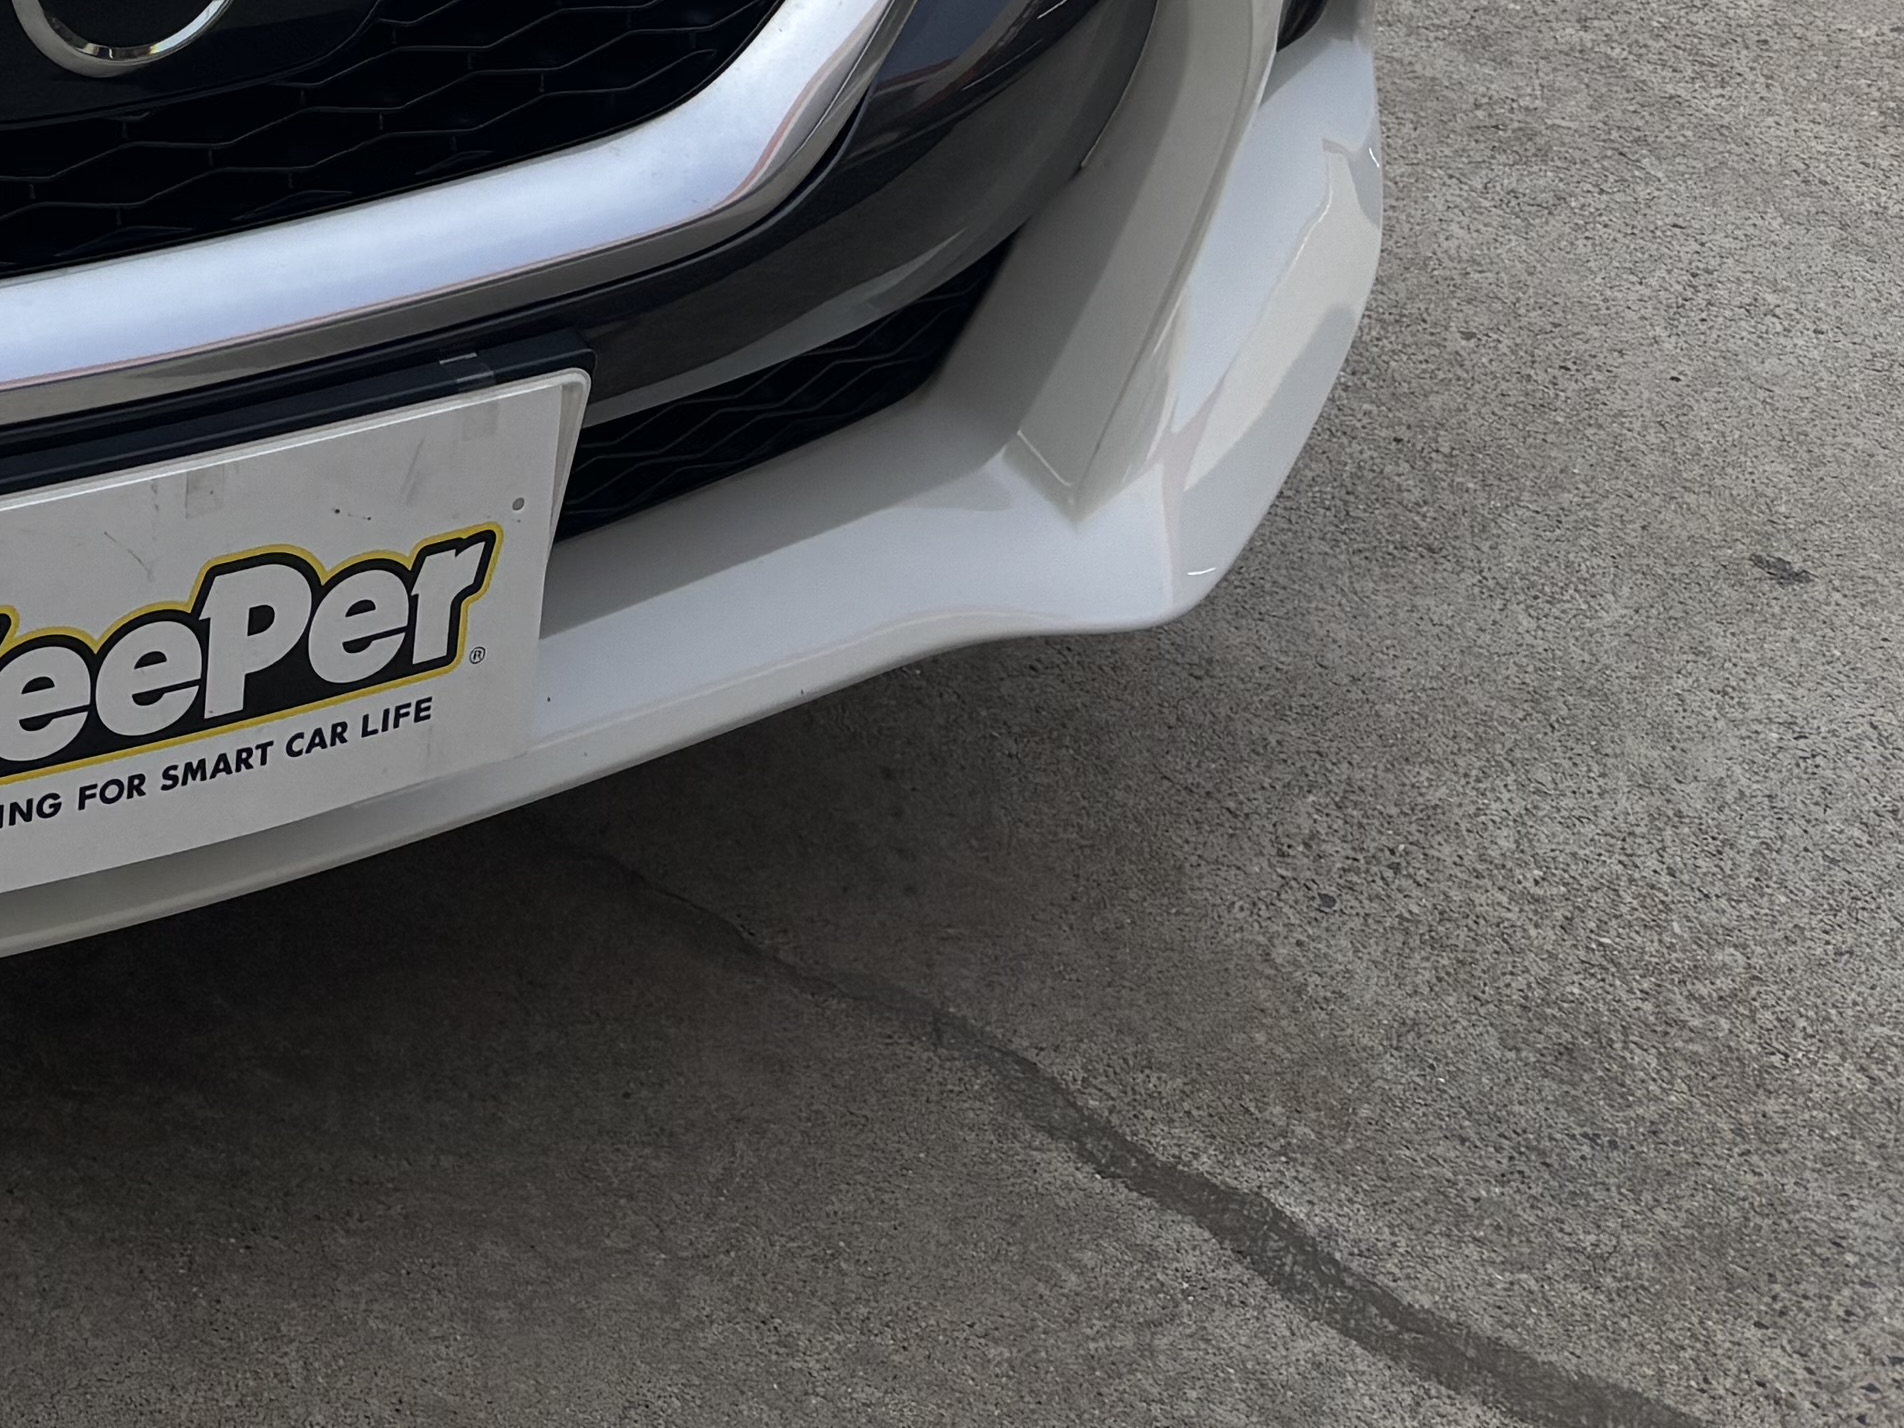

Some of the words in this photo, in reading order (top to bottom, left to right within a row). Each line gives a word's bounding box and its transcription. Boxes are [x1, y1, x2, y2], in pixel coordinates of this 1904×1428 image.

[78, 773, 147, 812] FOR
[160, 741, 275, 792] SMART
[285, 720, 350, 759] CAR
[360, 697, 434, 739] LIFE
